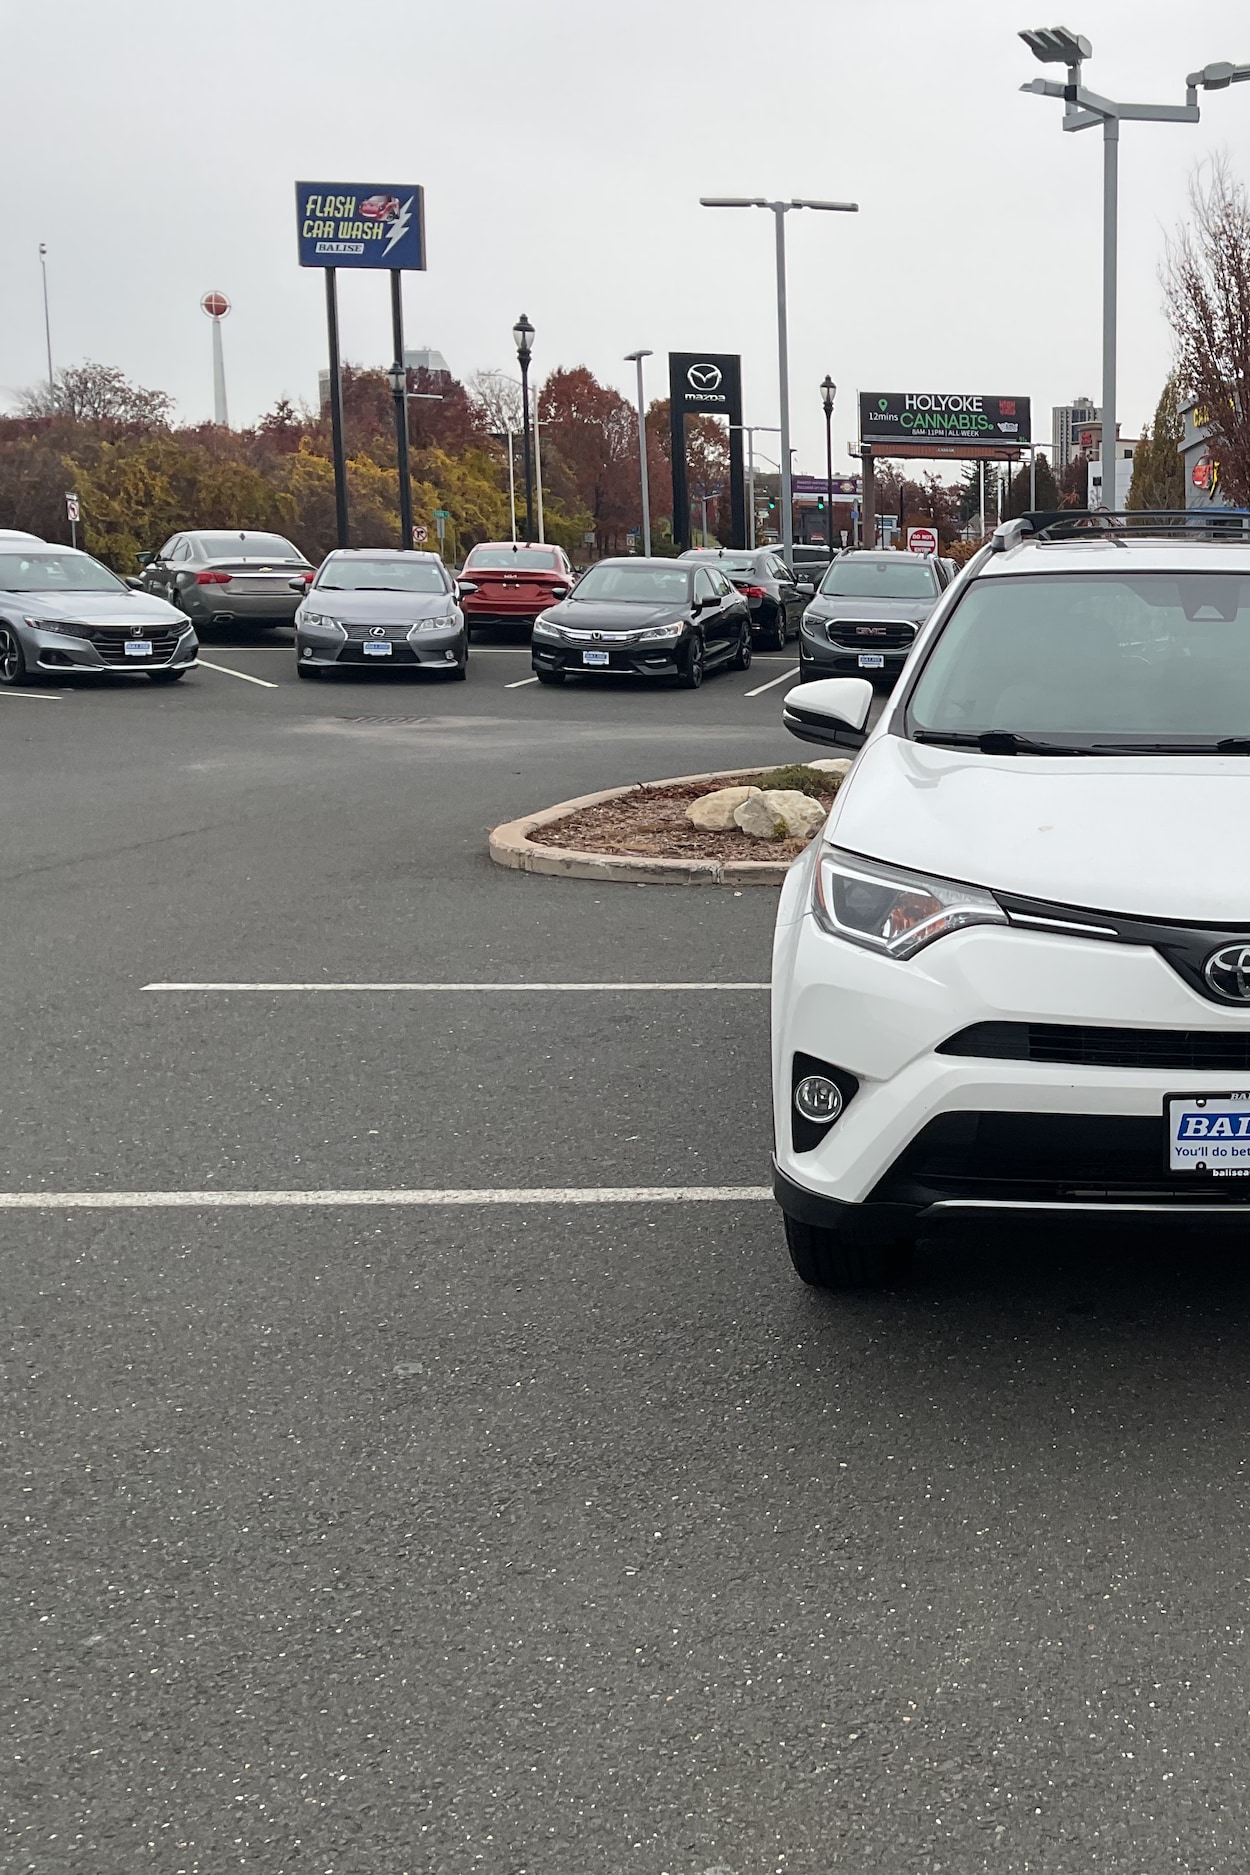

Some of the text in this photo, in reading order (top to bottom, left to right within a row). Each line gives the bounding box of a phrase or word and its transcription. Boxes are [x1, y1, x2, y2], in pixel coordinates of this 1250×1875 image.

[306, 195, 356, 218] FLASH
[303, 220, 384, 240] CAR WASH
[318, 243, 362, 252] BALISE
[685, 394, 726, 402] mazda
[905, 395, 983, 412] HOLYOKE
[869, 412, 898, 422] 12mins
[1175, 1146, 1208, 1157] You'll
[1212, 1146, 1228, 1157] do
